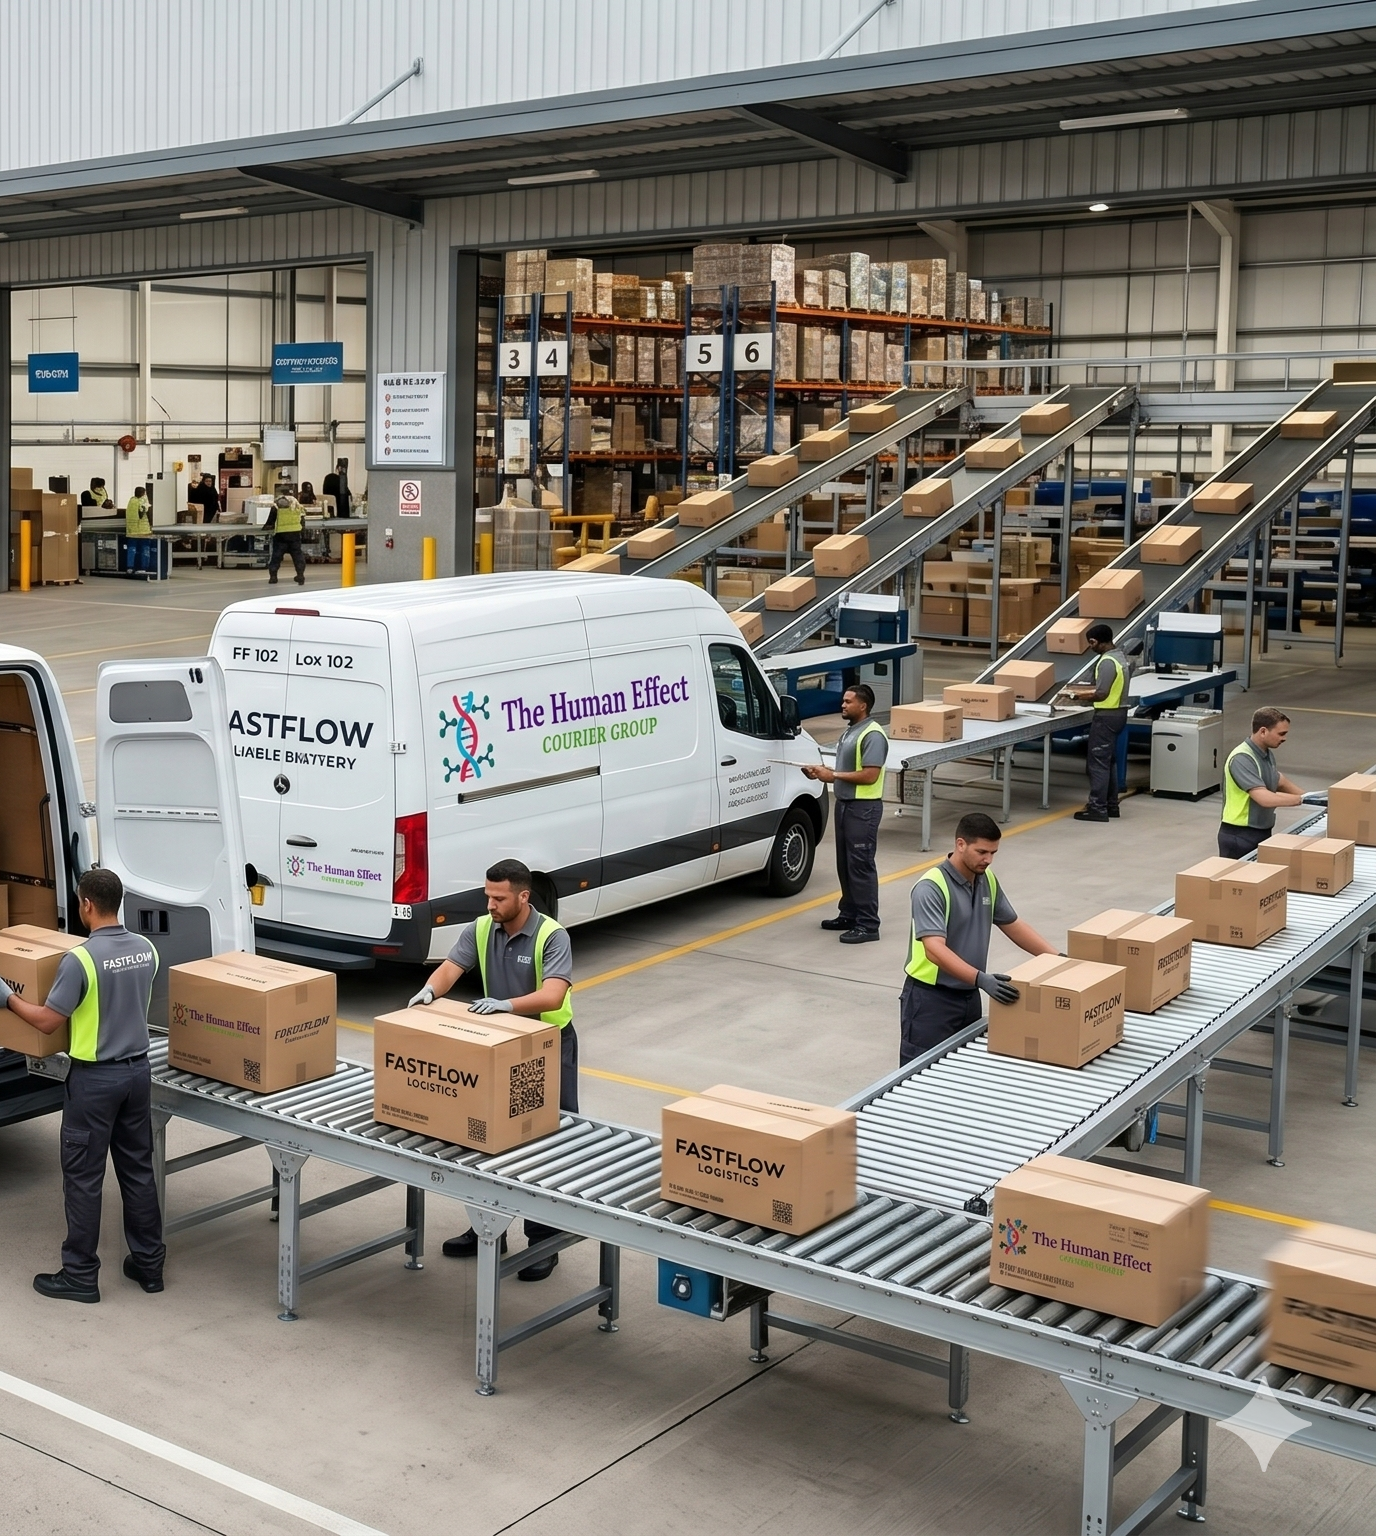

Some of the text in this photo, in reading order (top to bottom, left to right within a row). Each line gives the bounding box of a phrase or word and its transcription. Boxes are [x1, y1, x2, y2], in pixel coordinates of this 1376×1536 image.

[508, 349, 520, 369] 3
[545, 348, 558, 368] 4
[697, 343, 712, 365] 5
[744, 340, 760, 363] 6
[232, 646, 278, 663] FF 102
[327, 654, 353, 669] 102
[501, 675, 690, 733] The Human Effect
[228, 710, 374, 749] ASTFLOW
[542, 717, 658, 755] COURIER GROUP
[306, 861, 323, 873] The
[324, 864, 355, 878] Human
[189, 1009, 205, 1022] The
[236, 1020, 261, 1036] Effect
[385, 1051, 479, 1089] FASTFLOW
[675, 1138, 786, 1179] FASTFLOW
[698, 1163, 759, 1187] LOGISTICS
[1032, 1231, 1058, 1249] The
[1060, 1238, 1110, 1263] Human
[1112, 1250, 1153, 1274] Effect
